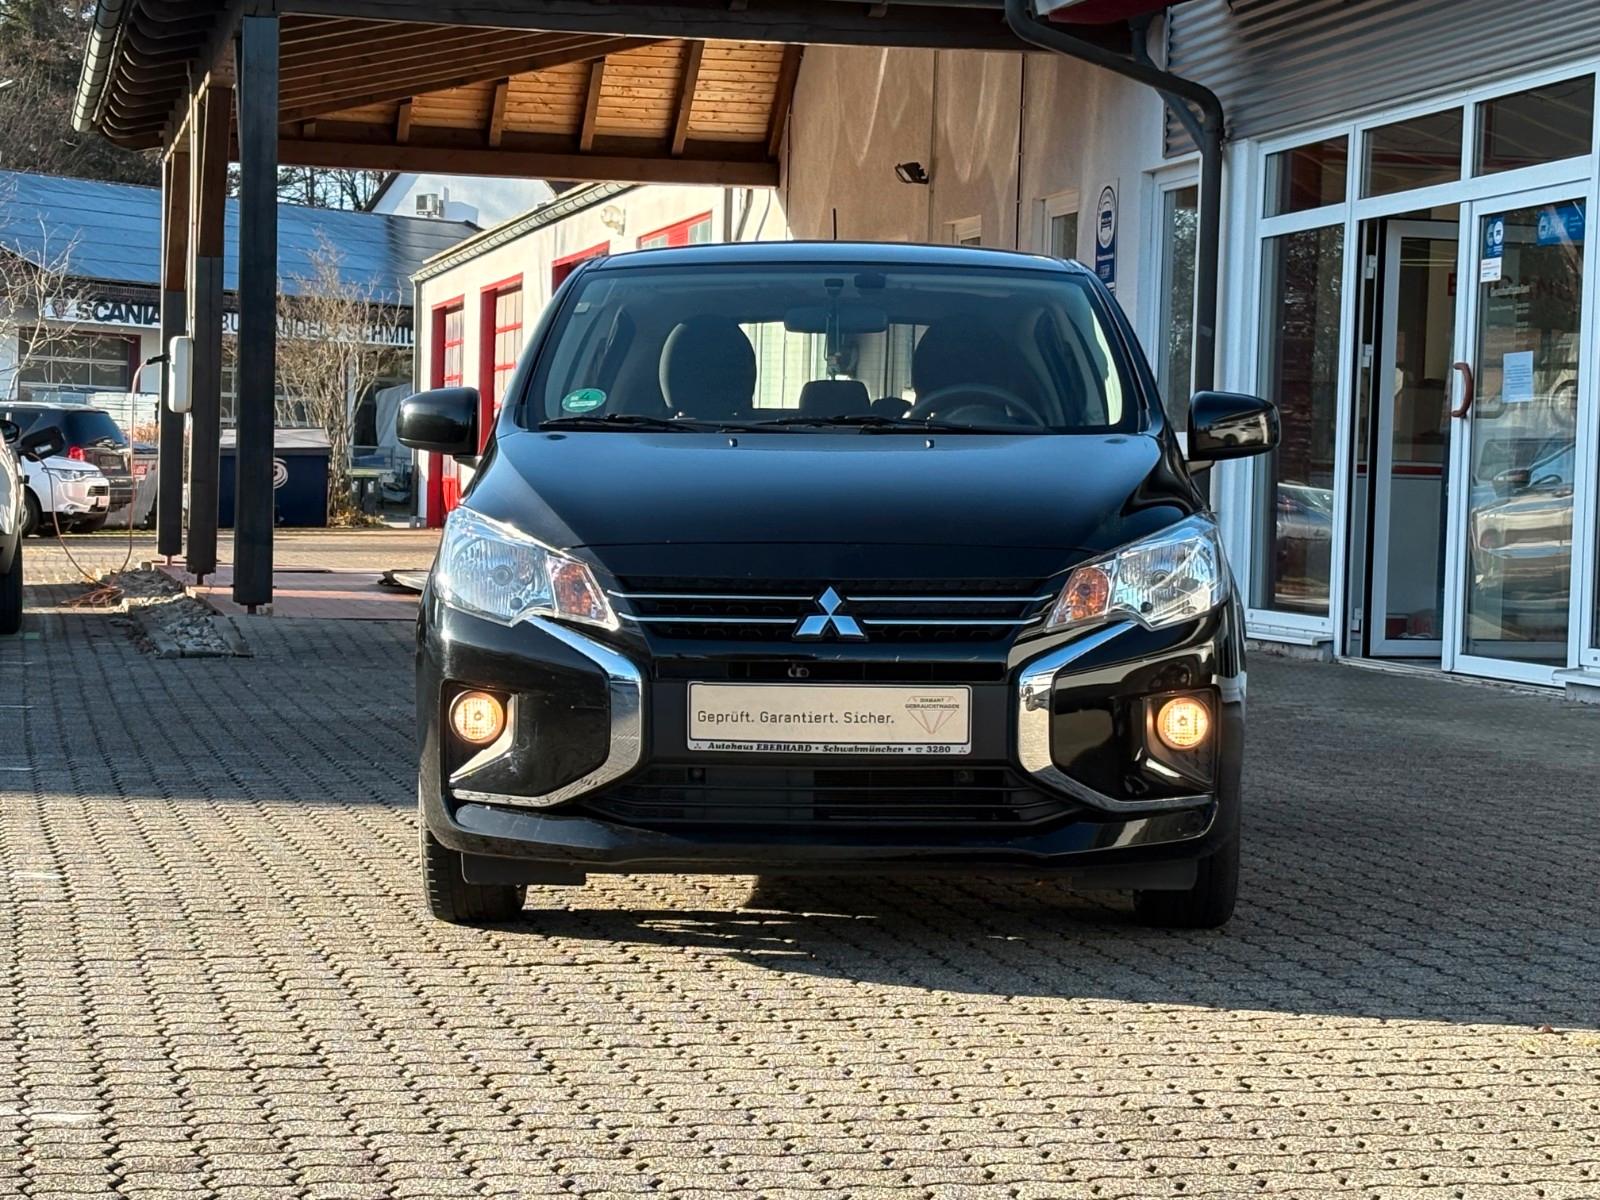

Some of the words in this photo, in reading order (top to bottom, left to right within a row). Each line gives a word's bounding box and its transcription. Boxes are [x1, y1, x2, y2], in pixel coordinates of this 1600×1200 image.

[76, 301, 161, 325] SCANIA
[697, 710, 755, 724] Geprüft.
[759, 711, 839, 724] Garantiert.
[843, 712, 895, 724] Sicher.
[707, 742, 754, 751] Autohaus
[756, 743, 812, 752] EBERHARD
[823, 744, 904, 753] Schwabmünchen
